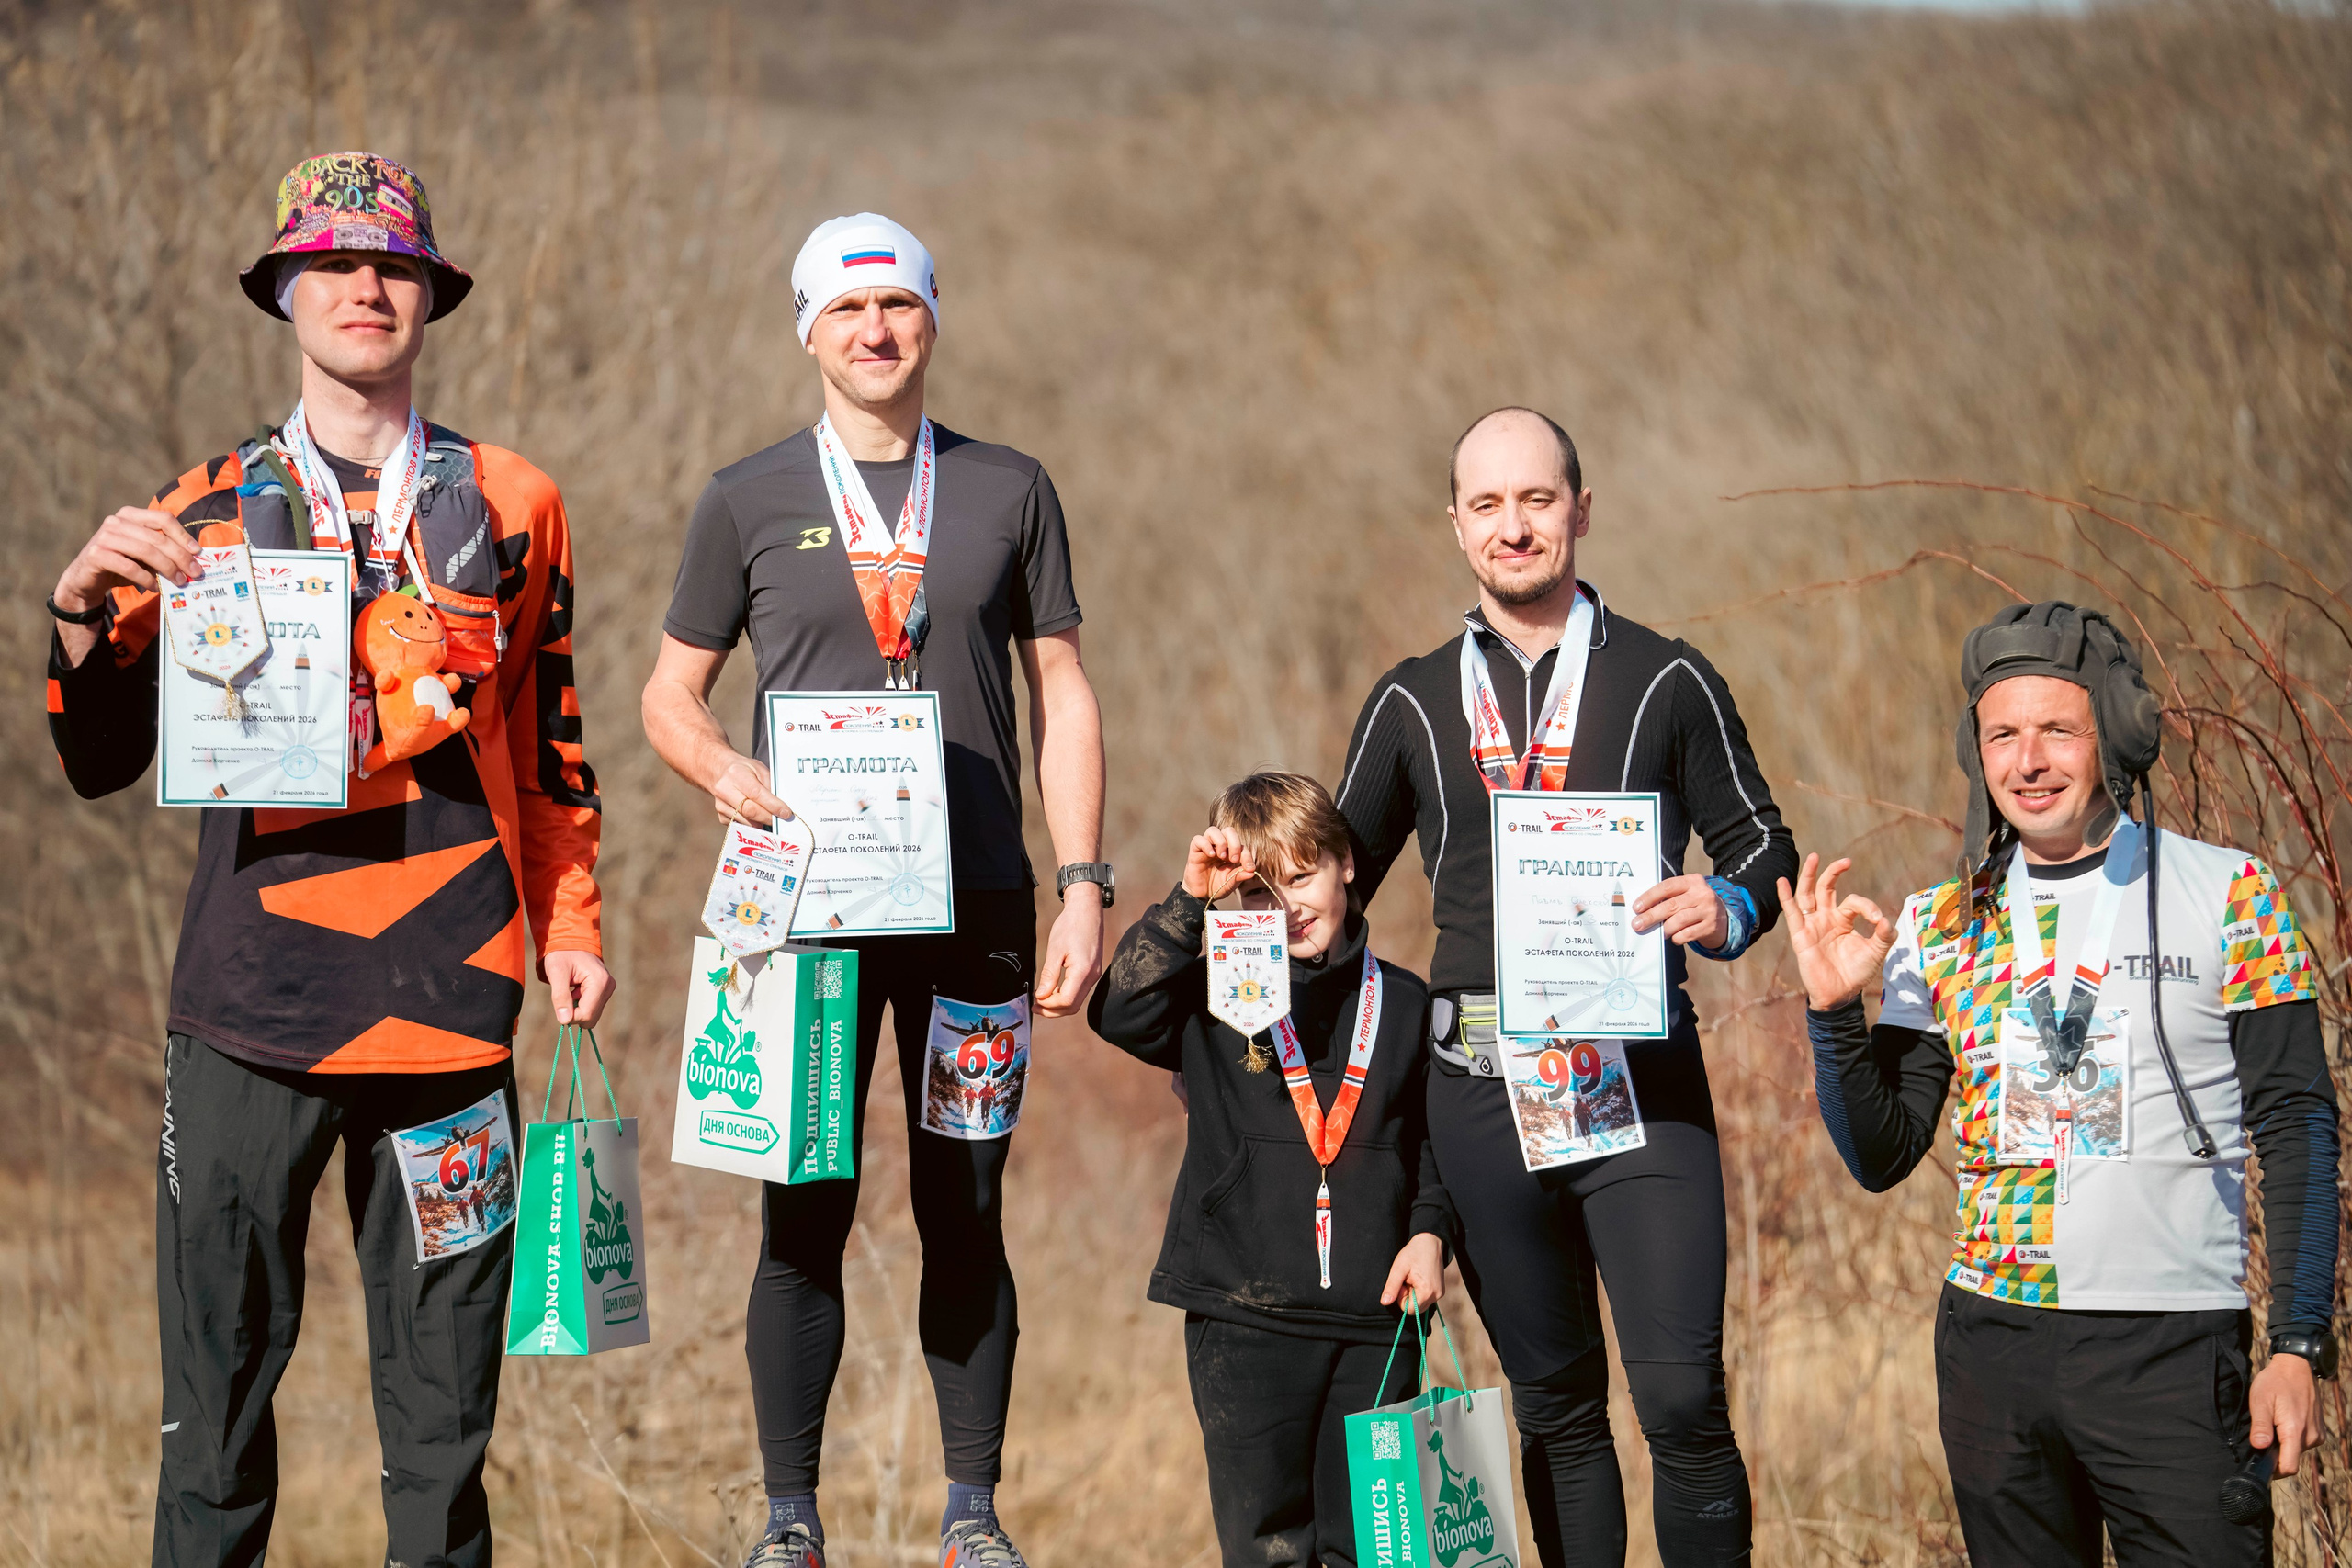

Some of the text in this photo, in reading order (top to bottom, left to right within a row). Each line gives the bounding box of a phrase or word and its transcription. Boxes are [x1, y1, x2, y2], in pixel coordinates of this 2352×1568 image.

[310, 154, 368, 176] BACK
[370, 161, 404, 184] TO
[337, 172, 371, 188] THE
[391, 423, 422, 524] ЛЕРМОНТОВ 2026
[919, 434, 932, 529] ЛЕРМОНТОВ 2026
[241, 713, 296, 724] ПОКОЛЕНИЙ
[298, 716, 318, 724] 2026
[785, 722, 822, 732] O-TRAIL
[797, 756, 919, 773] ГРАМОТА
[820, 815, 851, 823] Занявший
[1508, 821, 1544, 833] O-TRAIL
[847, 832, 878, 841] O-TRAIL
[812, 843, 922, 855] СТАФЕТА ПОКОЛЕНИЙ 2026
[1518, 859, 1634, 877] ГРАМОТА
[2032, 893, 2056, 901] -TRAIL
[1214, 918, 1253, 929] Эстафета
[1564, 937, 1594, 945] O-TRAIL
[2227, 926, 2255, 940] O-TRAIL
[732, 942, 744, 950] 2026
[1232, 946, 1263, 955] O-TRAIL
[1524, 948, 1635, 958] ЭСТАФЕТА ПОКОЛЕНИЙ 2026
[1360, 984, 1375, 1042] ЛЕРМОНТОВ
[956, 1029, 1016, 1080] 69
[688, 1051, 761, 1095] bionova
[1537, 1041, 1604, 1103] 99
[804, 1018, 822, 1175] ПОДПИШИСЬ
[828, 1019, 843, 1173] PUBLIC_BIONOVA
[703, 1117, 771, 1144] ДНЯ ОСНОВА
[438, 1125, 491, 1195] 67
[584, 1239, 633, 1269] bionova
[2018, 1249, 2051, 1258] O-TRAIL
[1959, 1270, 1979, 1285] O-TRAIL
[605, 1293, 639, 1314] ДНЯ ОСНОВА
[1696, 1508, 1739, 1519] ATHLEX
[1433, 1514, 1494, 1554] bionova
